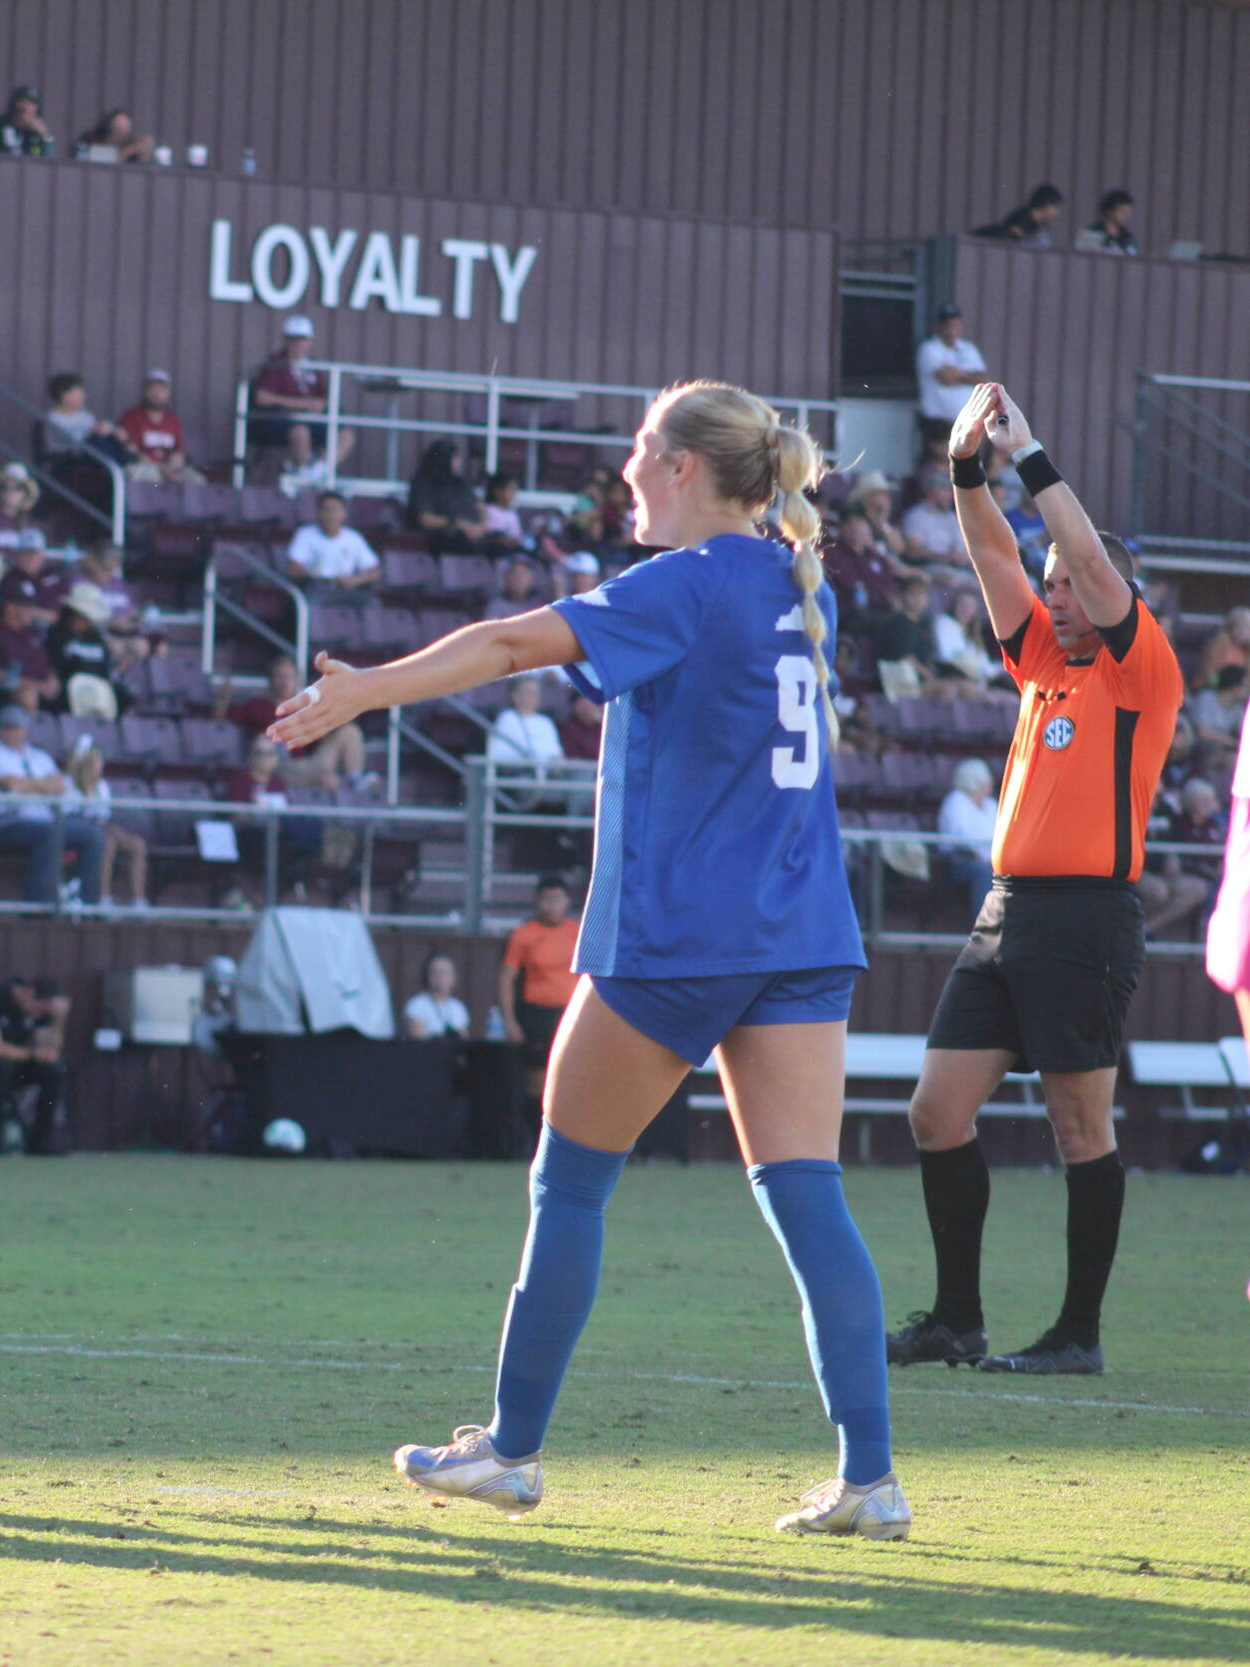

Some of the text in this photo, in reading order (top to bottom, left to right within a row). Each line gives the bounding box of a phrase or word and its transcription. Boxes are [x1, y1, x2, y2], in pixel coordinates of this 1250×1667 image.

[210, 219, 537, 323] LOYALTY
[771, 655, 820, 790] 9
[1045, 717, 1073, 748] SEC
